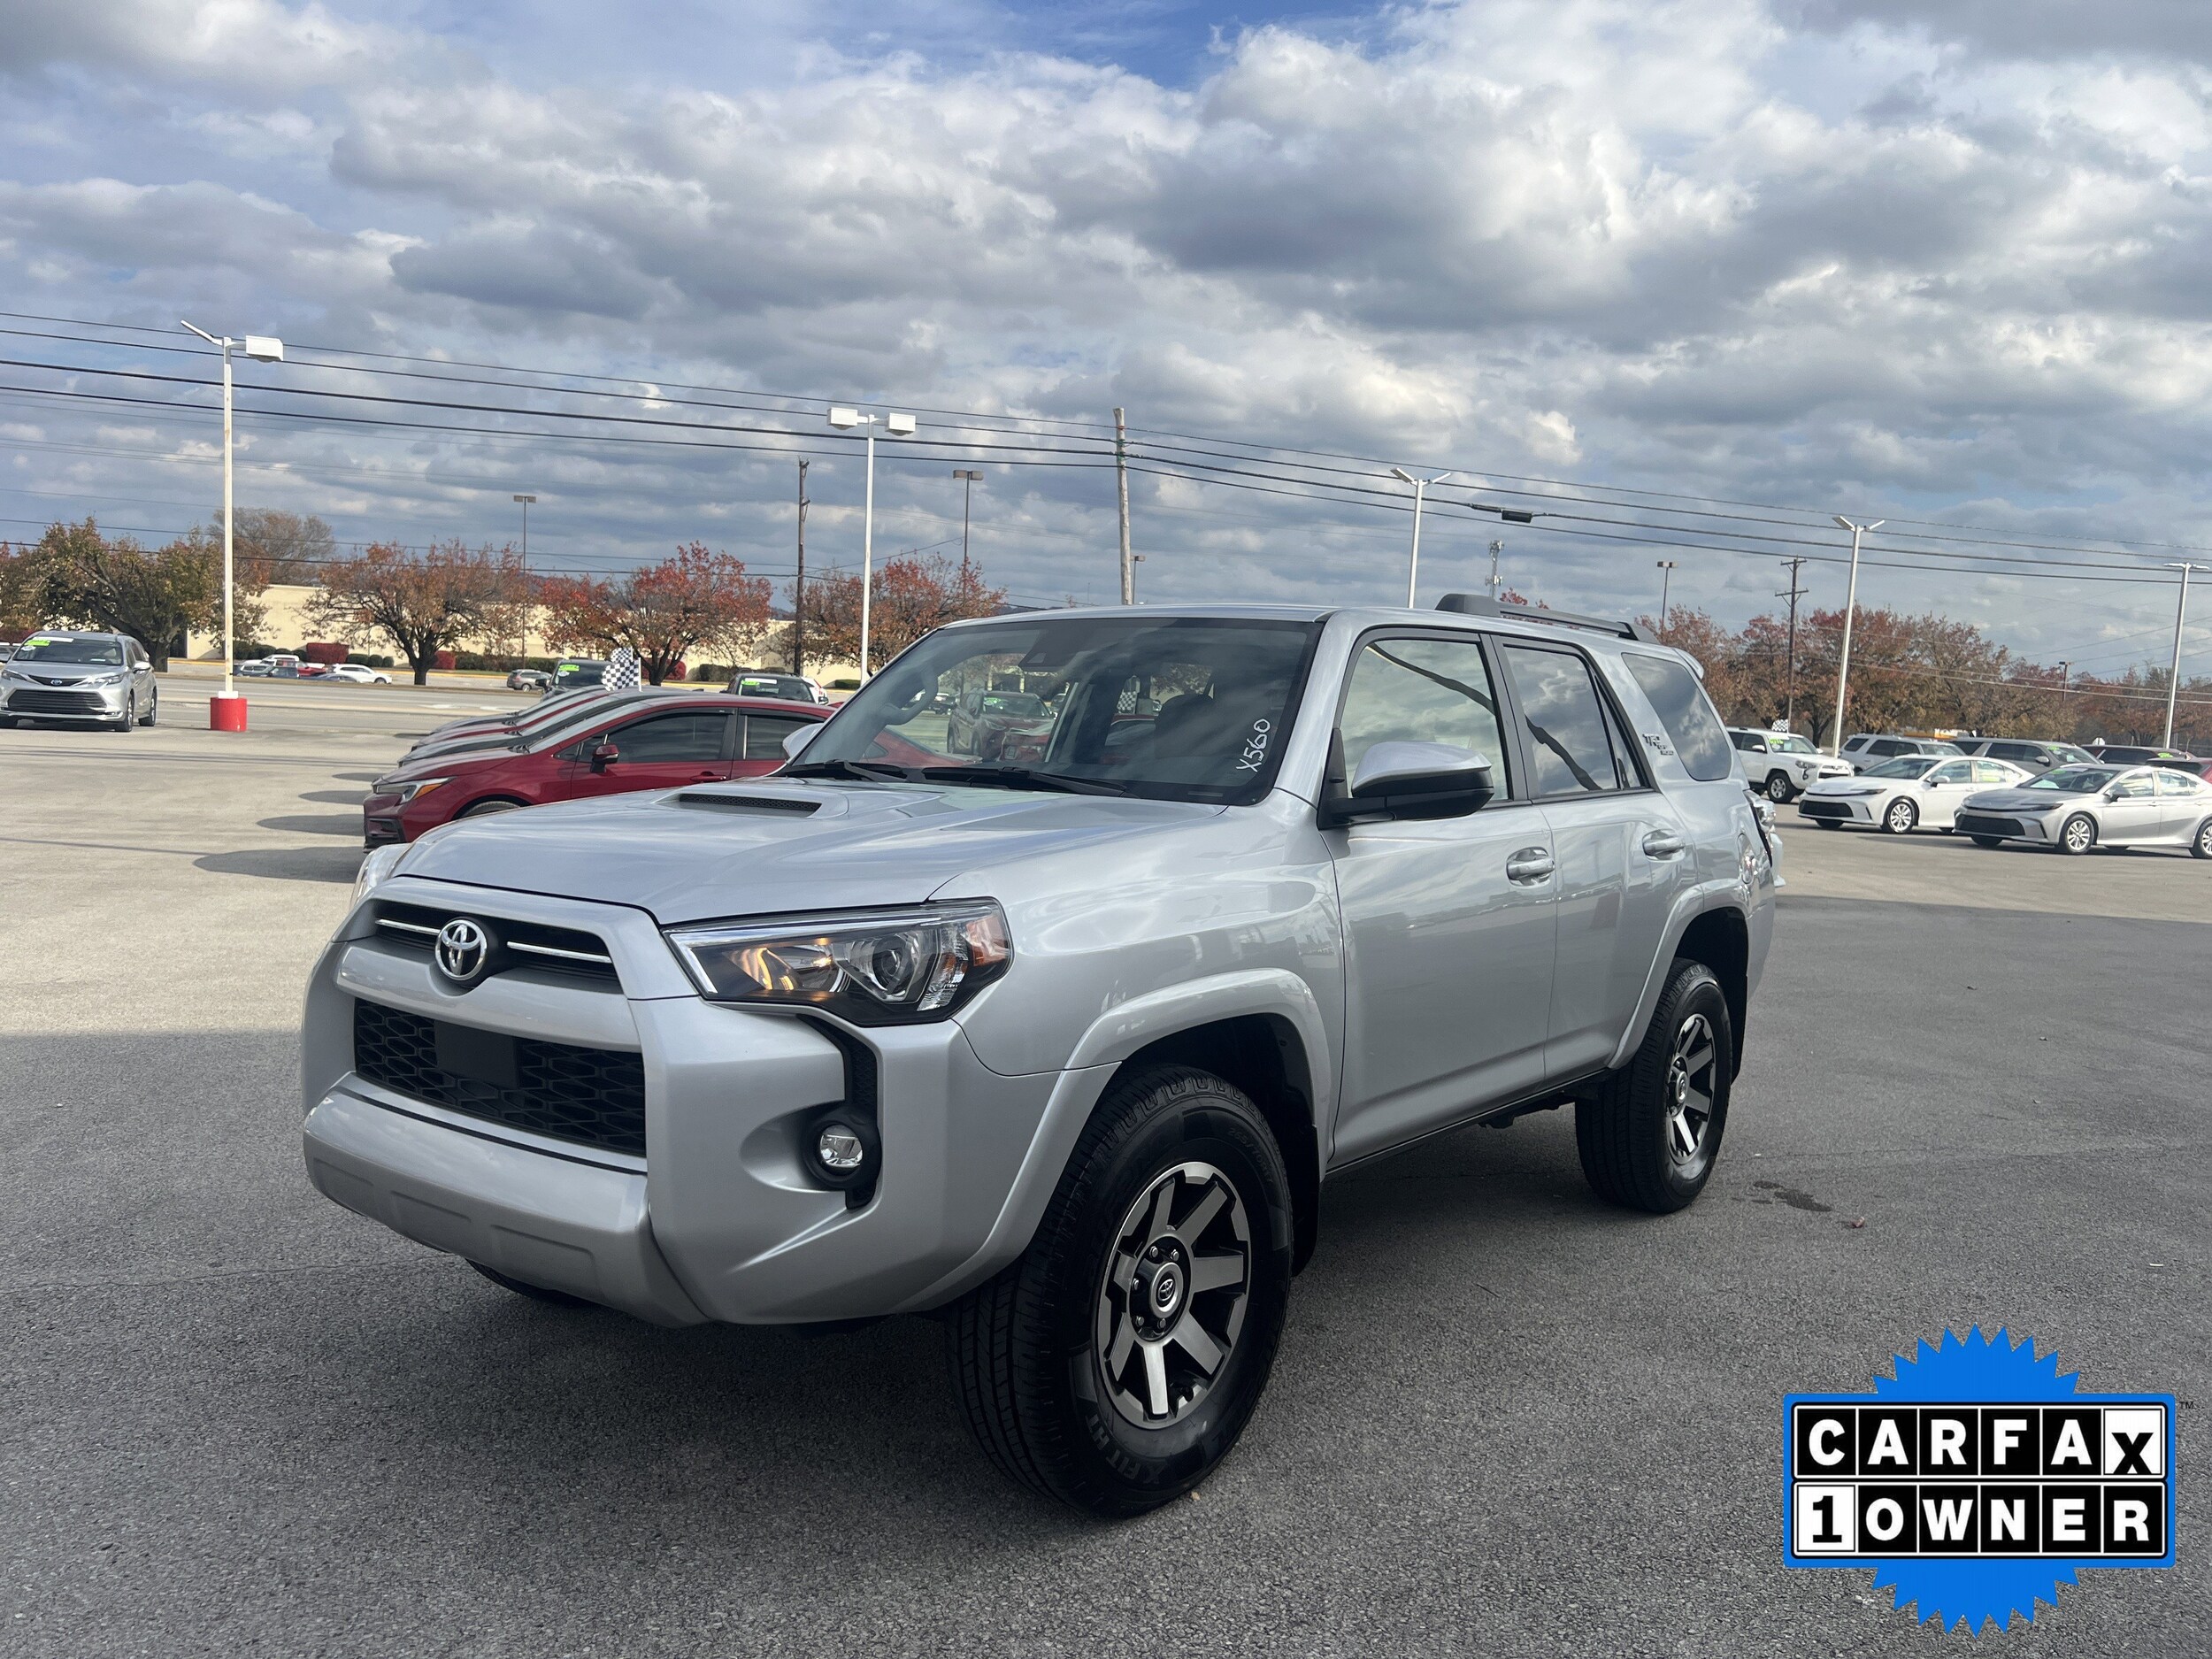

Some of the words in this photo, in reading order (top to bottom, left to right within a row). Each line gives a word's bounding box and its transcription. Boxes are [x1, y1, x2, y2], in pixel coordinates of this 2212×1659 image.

[1236, 718, 1271, 772] X560
[1085, 1414, 1110, 1450] HT
[1106, 1449, 1141, 1479] FIT
